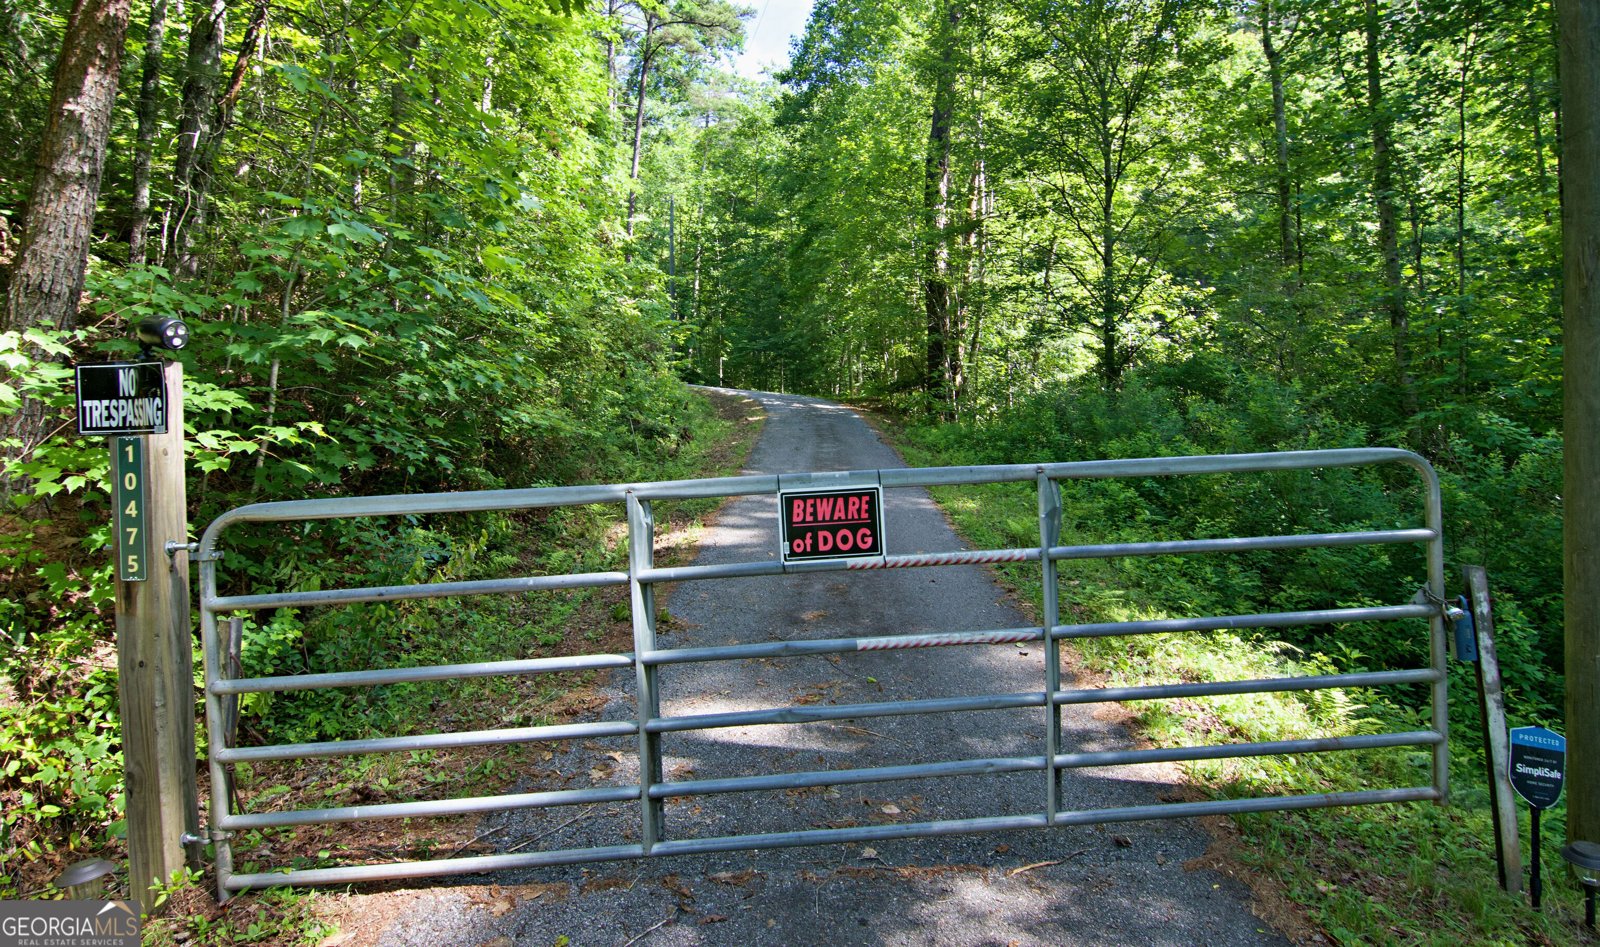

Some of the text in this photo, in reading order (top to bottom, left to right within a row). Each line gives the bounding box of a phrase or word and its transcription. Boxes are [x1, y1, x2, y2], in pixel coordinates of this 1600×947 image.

[119, 368, 136, 397] NO
[83, 397, 162, 428] TRESPASSING
[124, 445, 139, 573] 10475
[792, 495, 870, 522] BEWARE
[792, 527, 873, 553] of DOG
[1518, 733, 1560, 746] PROTECTED
[1515, 763, 1562, 780] SimpliSafe
